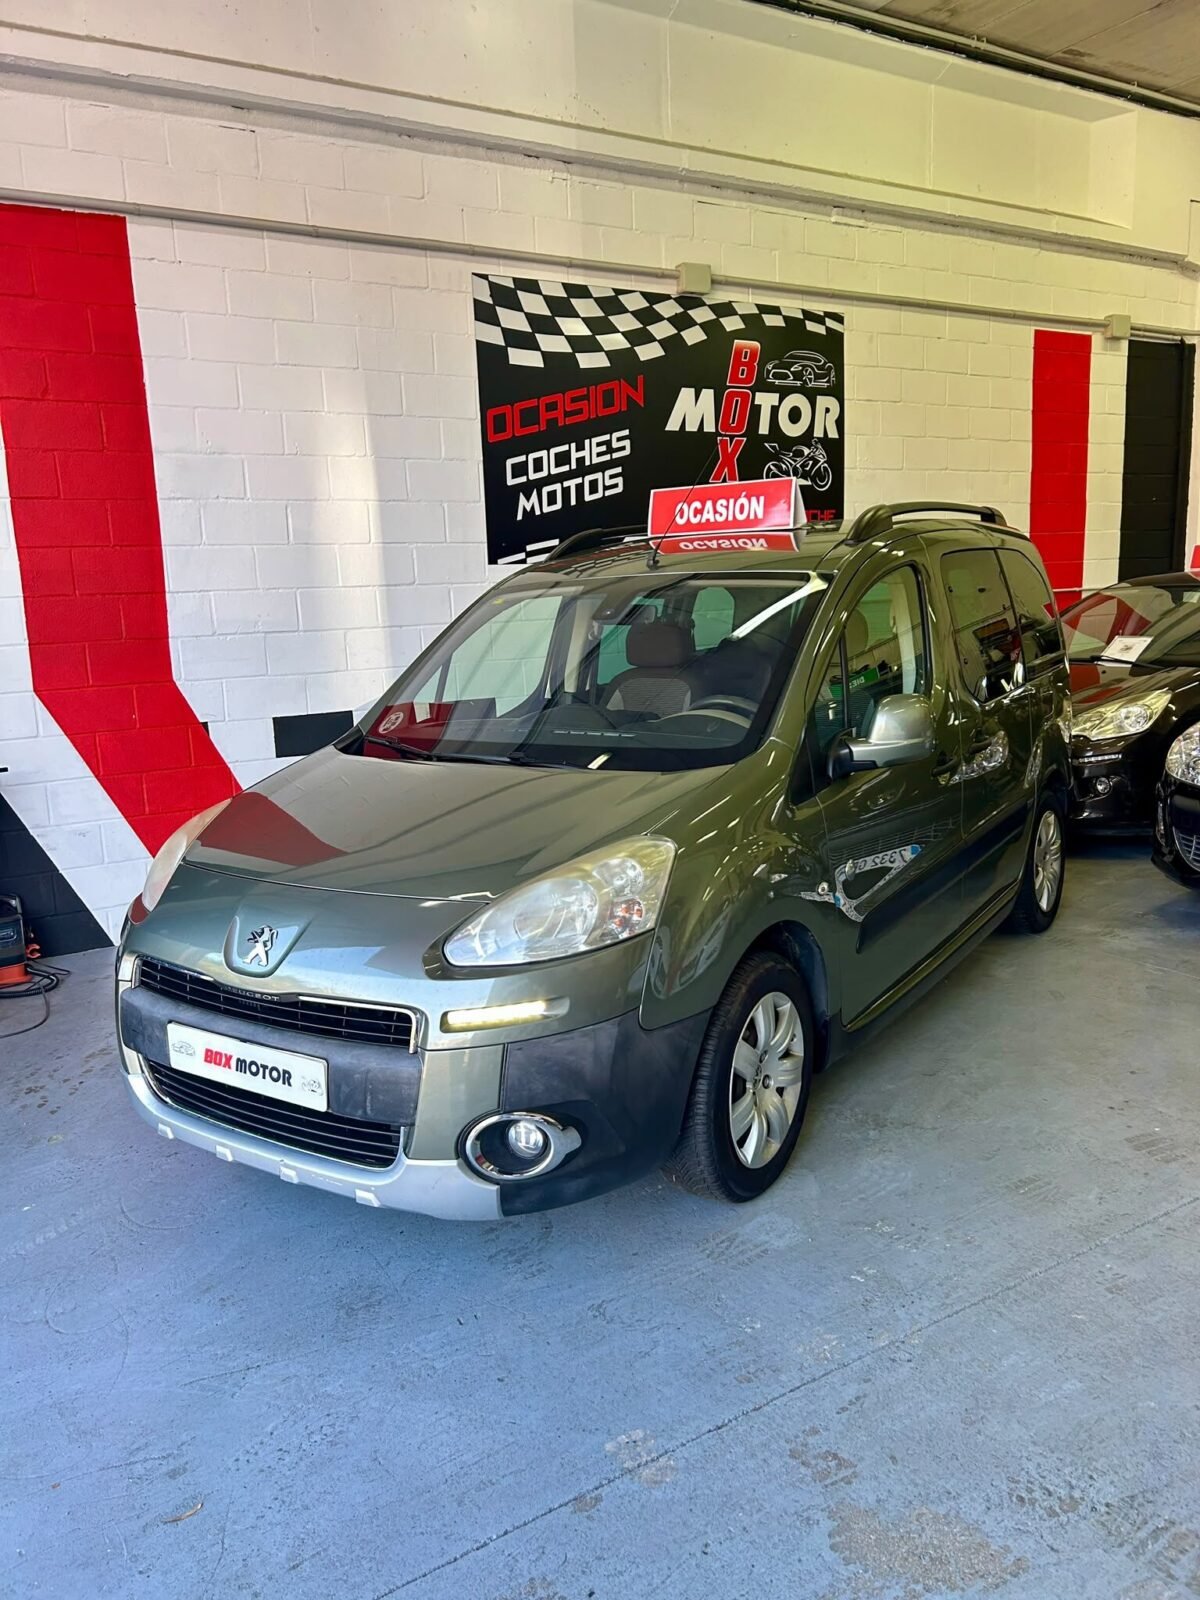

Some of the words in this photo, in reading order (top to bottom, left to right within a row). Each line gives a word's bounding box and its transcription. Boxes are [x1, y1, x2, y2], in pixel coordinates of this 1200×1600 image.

[486, 374, 645, 444] OCASION
[710, 339, 762, 483] BOX
[505, 428, 632, 486] COCHES
[517, 466, 624, 521] MOTOS
[674, 491, 765, 525] OCASIÓN
[203, 1047, 234, 1070] BOX
[235, 1056, 293, 1087] MOTOR
